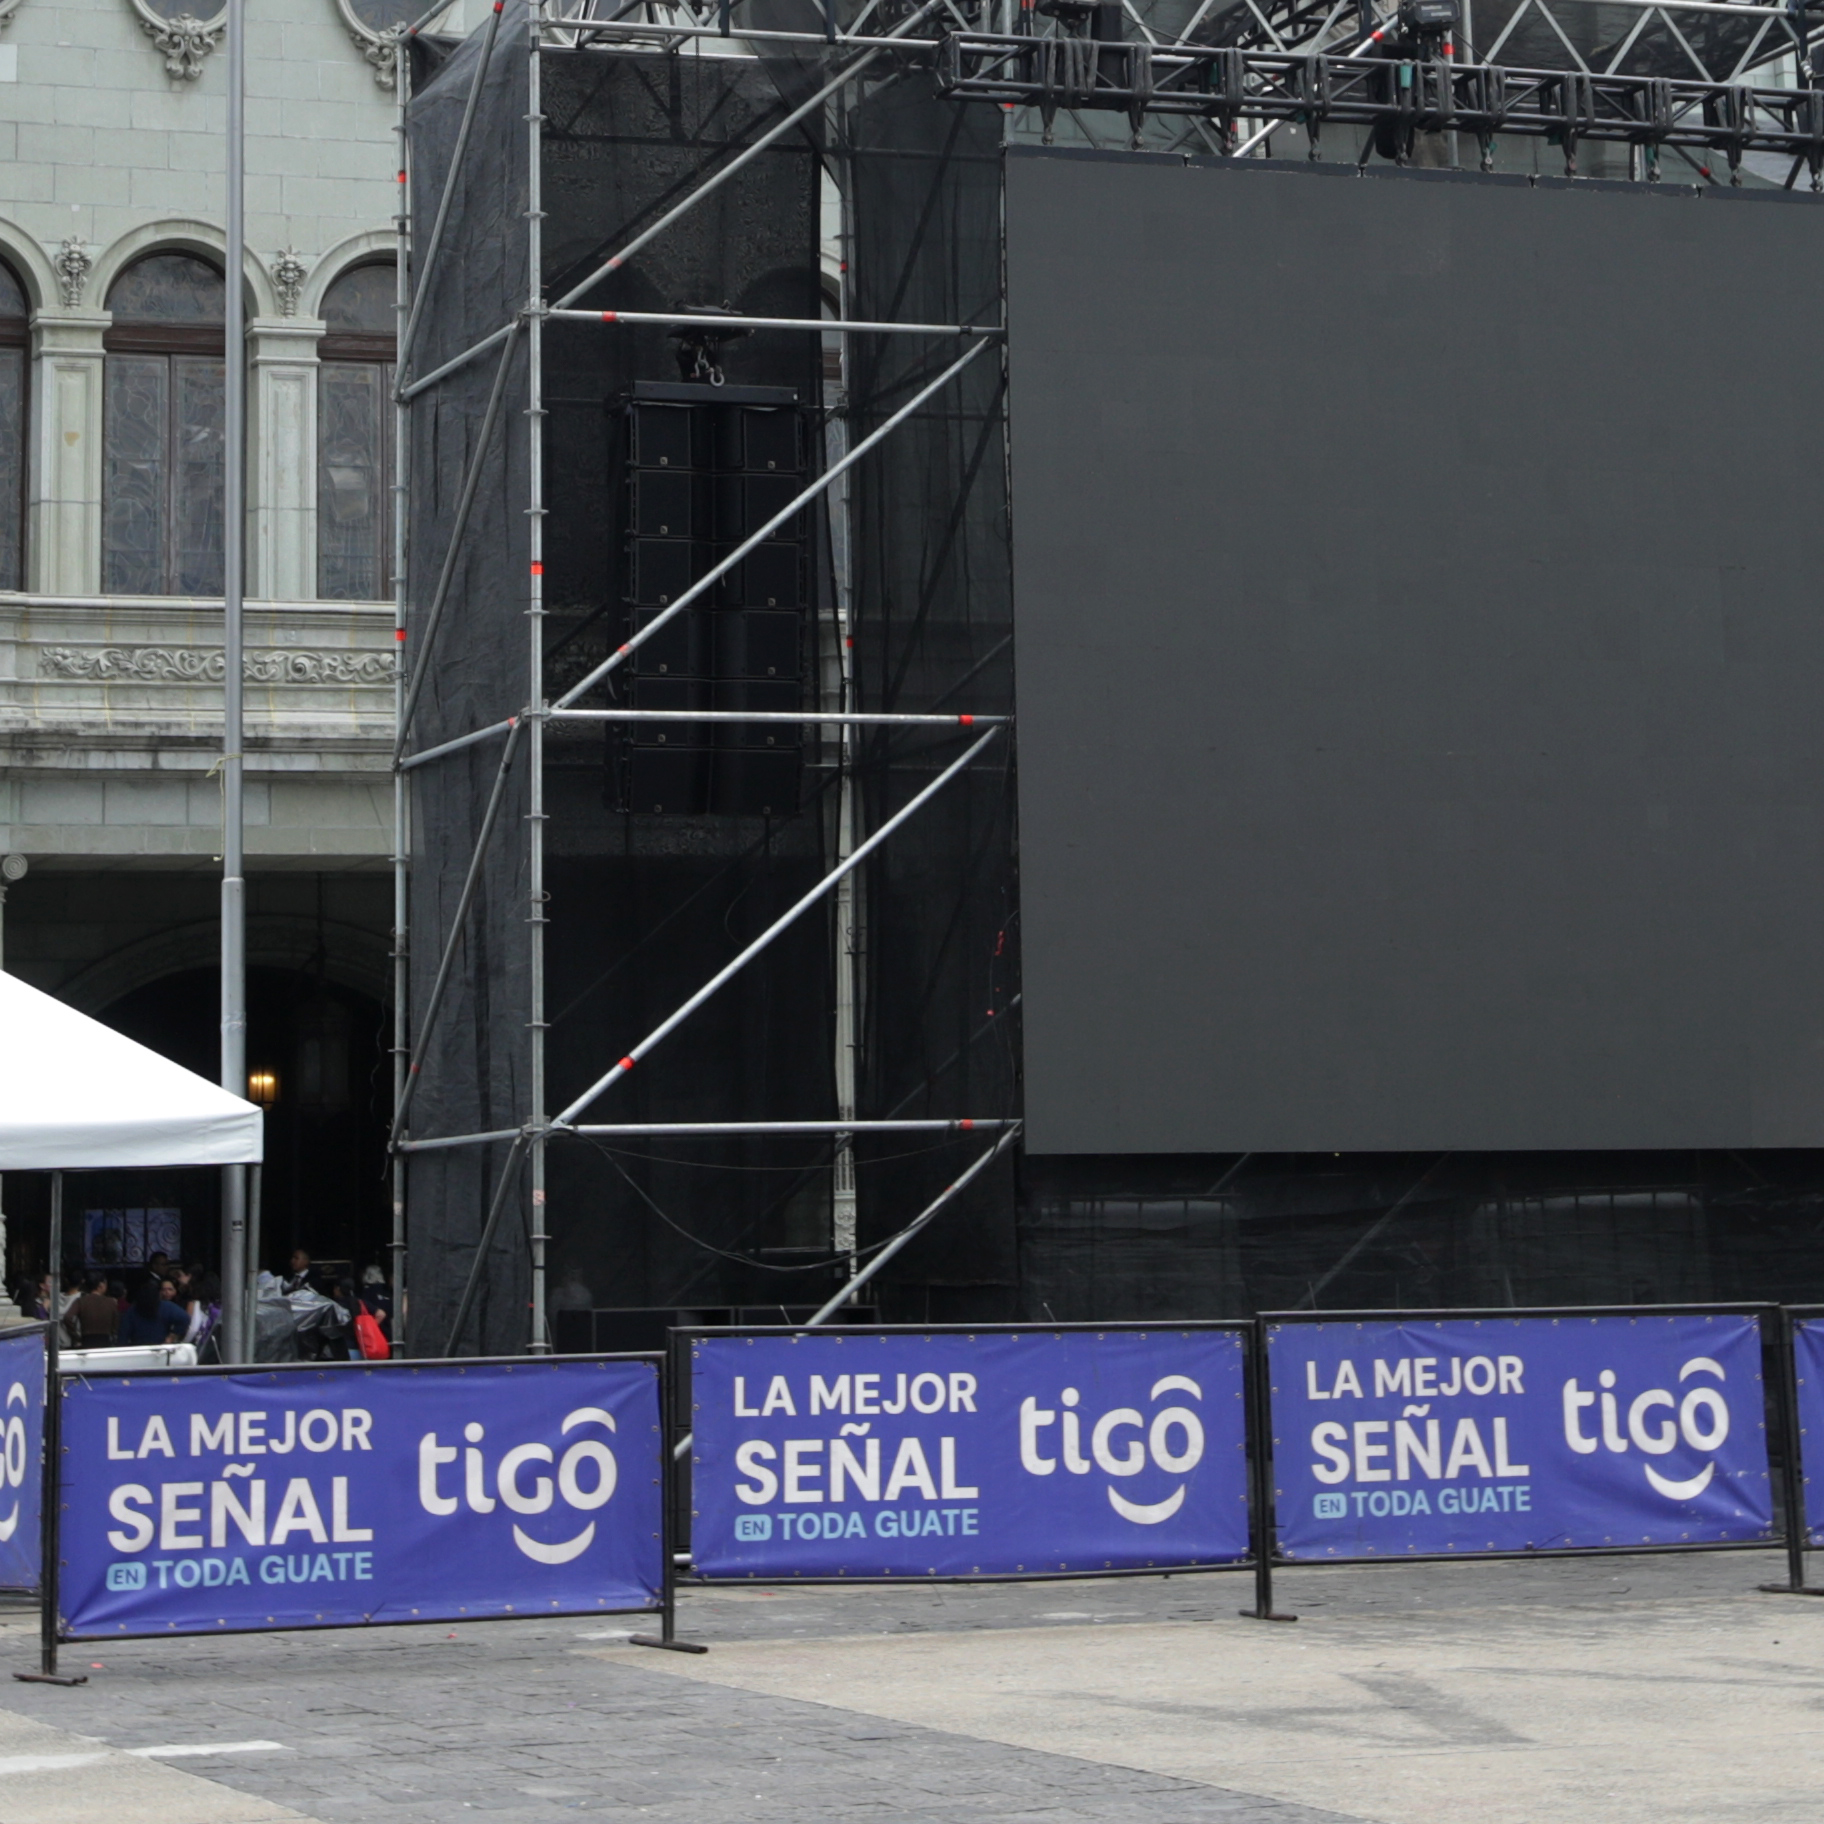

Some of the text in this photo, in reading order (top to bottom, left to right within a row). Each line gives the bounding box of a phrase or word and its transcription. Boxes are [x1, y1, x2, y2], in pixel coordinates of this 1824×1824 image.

[735, 1372, 977, 1417] LA MEJOR
[1307, 1356, 1524, 1400] LA MEJOR
[108, 1409, 372, 1460] LA MEJOR
[1311, 1404, 1530, 1484] SEÑAL
[735, 1422, 979, 1505] SEÑAL
[108, 1463, 373, 1552] SEÑAL
[777, 1512, 867, 1540] TODA
[875, 1509, 979, 1538] GUATE
[1351, 1490, 1431, 1518] TODA
[1438, 1486, 1531, 1514] GUATE
[152, 1557, 250, 1589] TODA
[260, 1552, 373, 1584] GUATE
